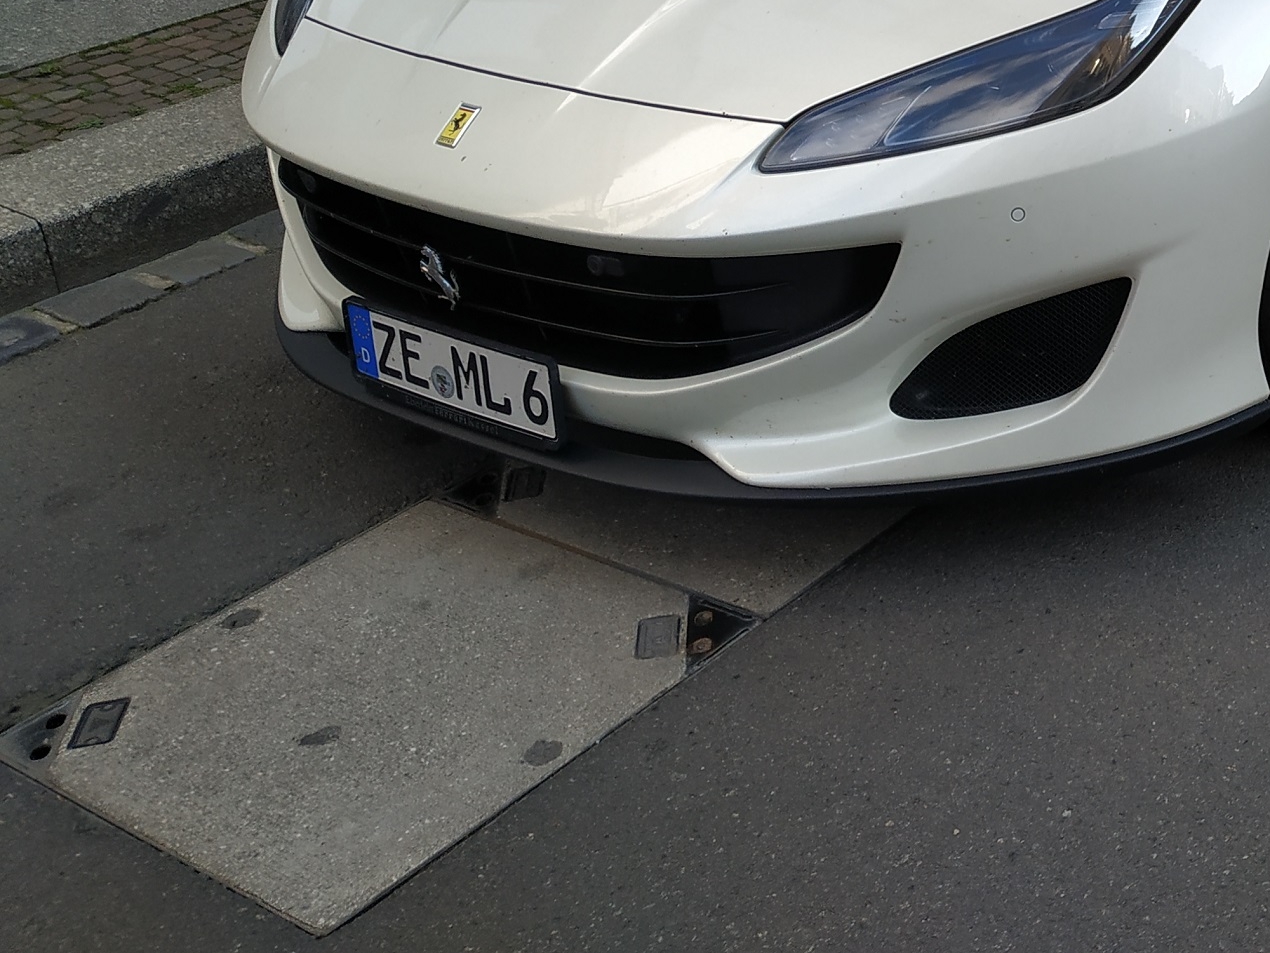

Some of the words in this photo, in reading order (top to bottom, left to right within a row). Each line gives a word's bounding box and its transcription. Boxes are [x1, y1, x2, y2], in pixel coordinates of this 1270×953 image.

[361, 347, 371, 363] D
[372, 320, 430, 390] ZE
[451, 345, 512, 416] ML
[523, 369, 549, 426] 6
